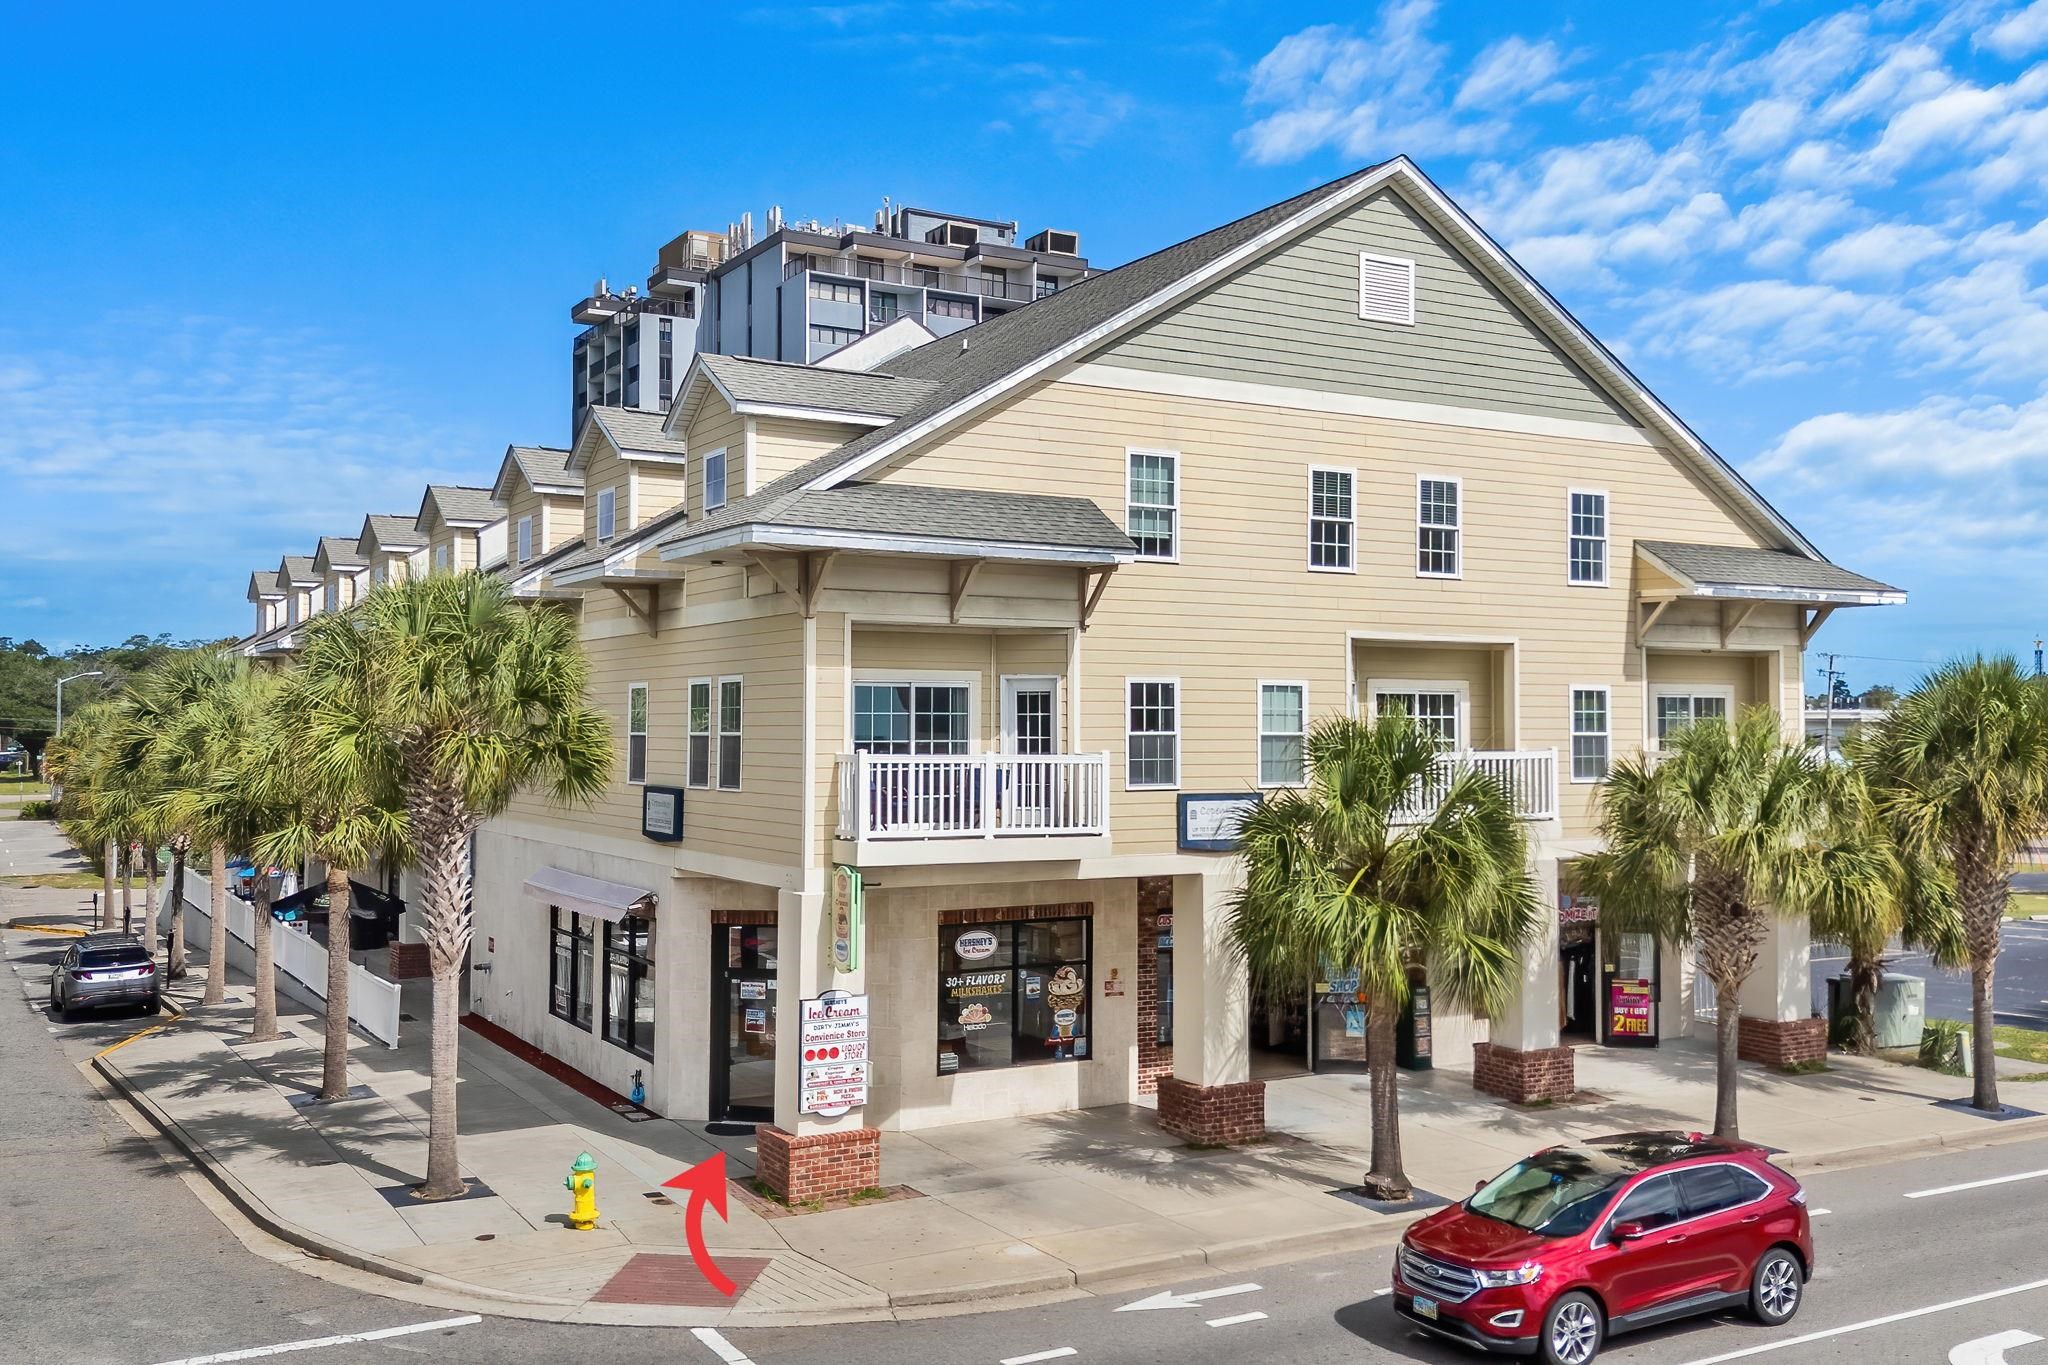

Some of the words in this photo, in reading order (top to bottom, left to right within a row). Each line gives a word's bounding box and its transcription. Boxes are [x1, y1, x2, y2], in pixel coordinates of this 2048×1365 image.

[959, 937, 993, 947] HERSHEY'S
[945, 977, 963, 987] 30+
[966, 973, 1007, 986] FLAVORS
[951, 984, 1004, 997] MILKSHAKES
[1329, 980, 1359, 993] SHOP
[809, 1007, 824, 1020] Ice
[825, 1006, 861, 1018] Cream
[834, 1021, 860, 1029] JIMMY'S
[1613, 1015, 1625, 1031] 2
[1626, 1019, 1647, 1032] FREE
[846, 1030, 866, 1039] Store
[841, 1043, 866, 1053] LIQUOR
[844, 1051, 864, 1060] STORE
